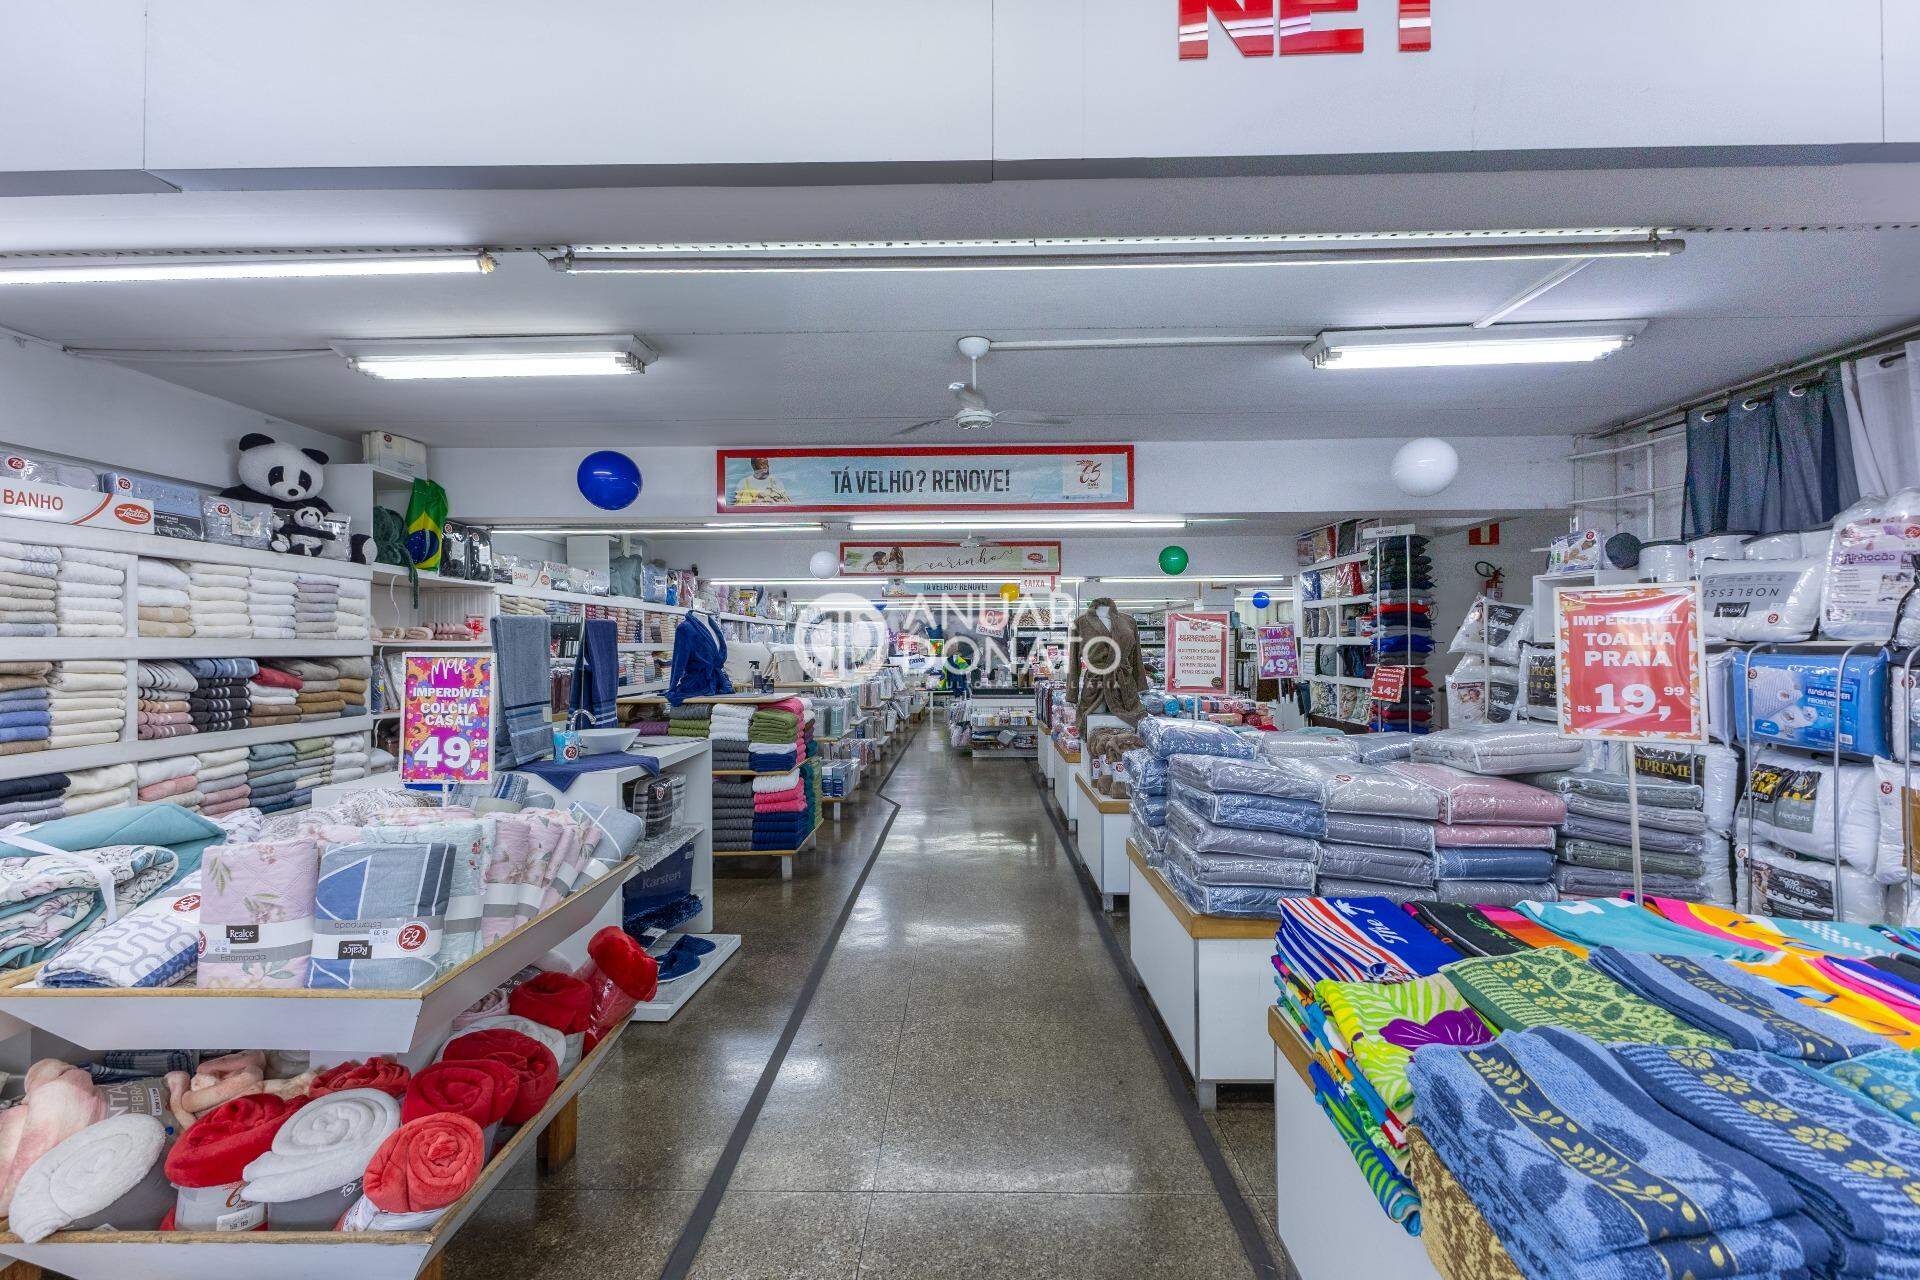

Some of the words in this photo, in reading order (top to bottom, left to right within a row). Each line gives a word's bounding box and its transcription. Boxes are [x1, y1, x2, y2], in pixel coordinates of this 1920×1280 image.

[831, 466, 853, 493] TÁ
[855, 469, 927, 493] VELHO?
[932, 469, 1010, 493] RENOVE!
[3, 489, 64, 511] BANHO
[1024, 580, 1045, 588] CAIXA
[1583, 632, 1676, 646] TOALHA
[1584, 650, 1673, 667] PRAIA
[412, 686, 487, 698] IMPERDÍVEL
[1807, 687, 1851, 700] NASASUER
[420, 702, 479, 715] COLCHA
[1577, 705, 1591, 713] R$
[425, 714, 474, 727] CASAL
[641, 871, 681, 889] Karsten
[229, 929, 255, 938] Realce
[342, 947, 368, 956] Realce
